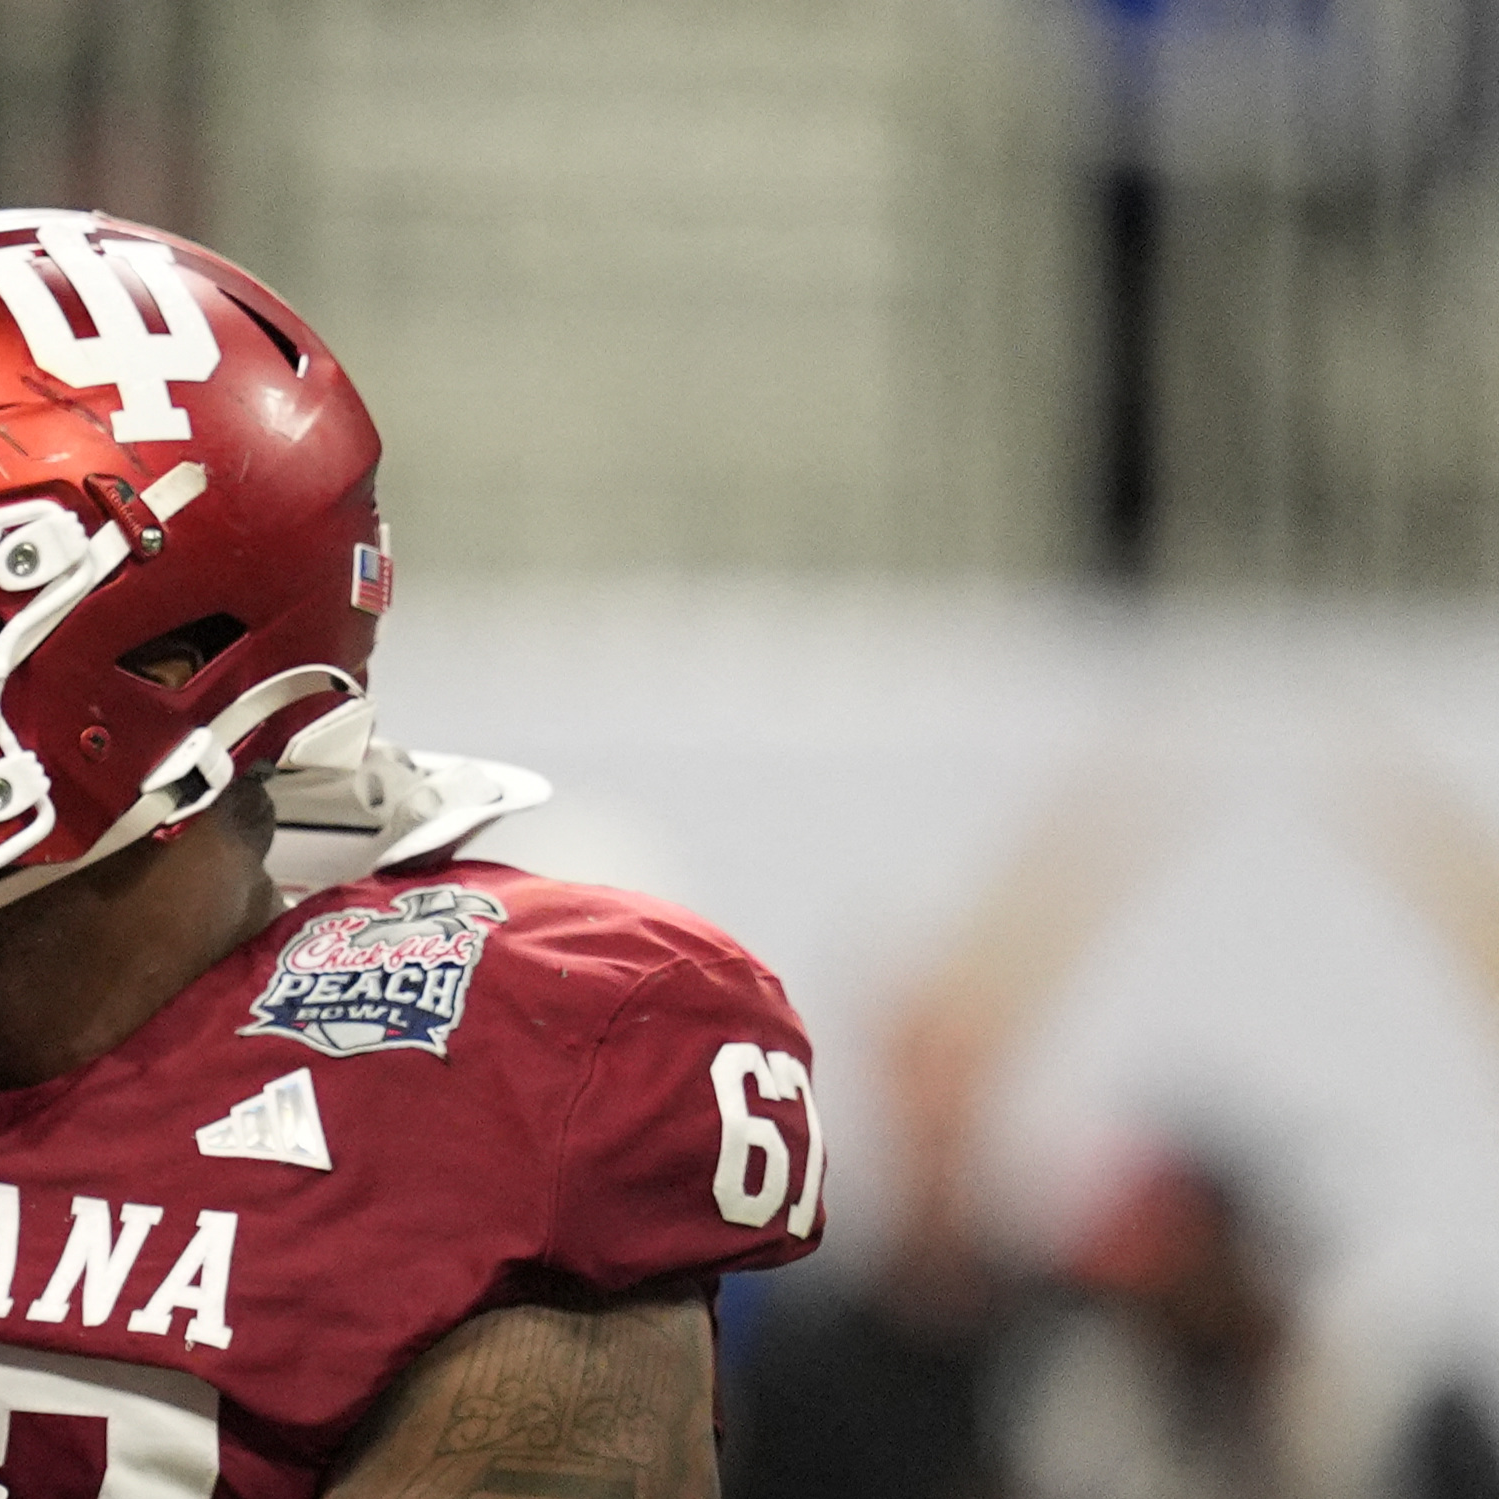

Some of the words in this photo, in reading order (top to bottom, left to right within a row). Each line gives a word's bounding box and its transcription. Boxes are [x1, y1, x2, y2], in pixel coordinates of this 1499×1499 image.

[263, 965, 463, 1018] PEACH
[295, 1002, 409, 1029] BOWL
[709, 1042, 824, 1240] 67
